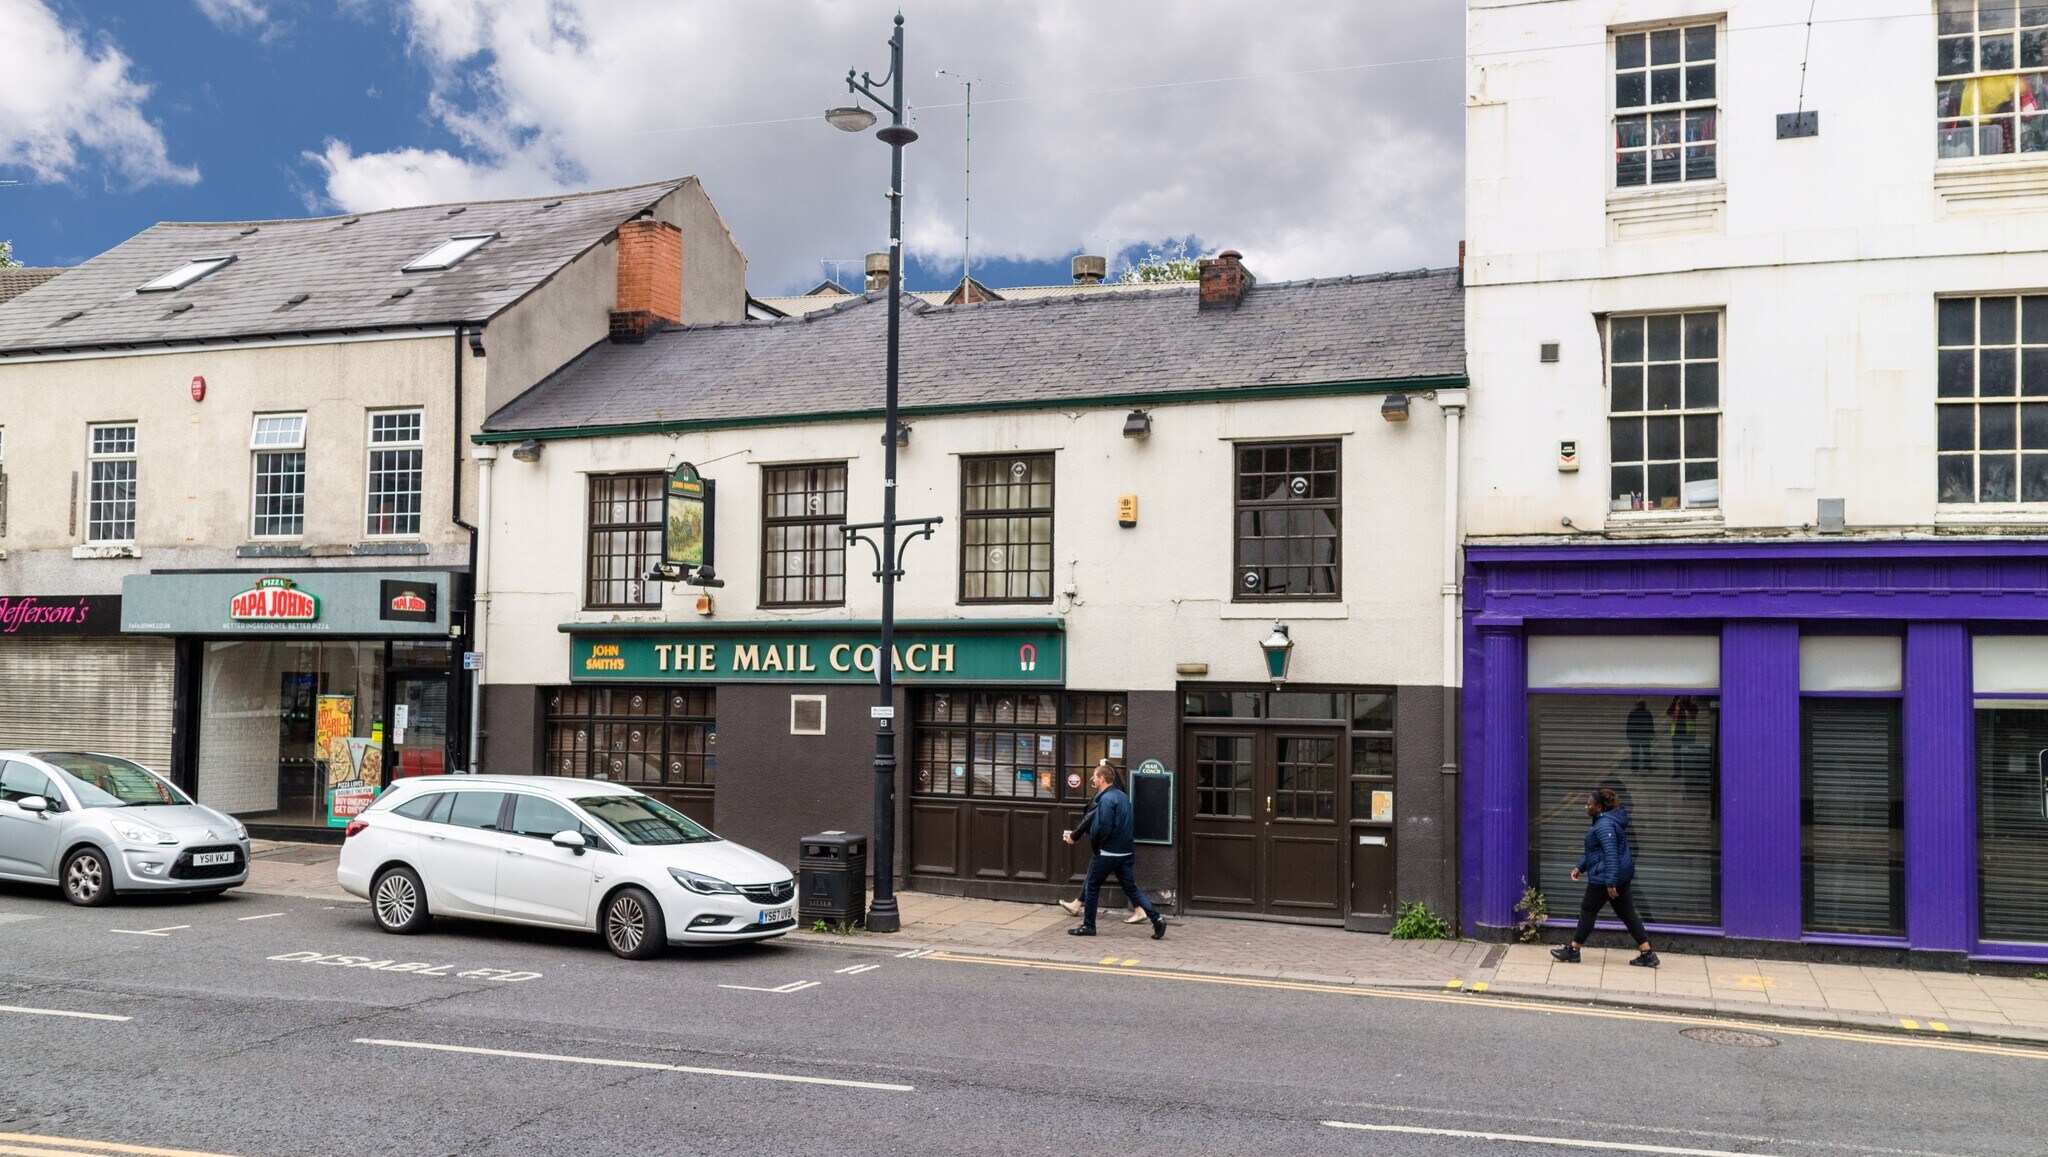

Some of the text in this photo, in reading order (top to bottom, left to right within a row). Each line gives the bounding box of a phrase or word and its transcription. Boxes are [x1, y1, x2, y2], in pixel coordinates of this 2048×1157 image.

[262, 578, 284, 586] PIZZA
[232, 590, 313, 617] PAPA JOHNS
[222, 622, 245, 630] BETTER
[287, 622, 311, 630] BETTER
[592, 644, 619, 657] JOHN
[654, 644, 717, 671] THE
[732, 644, 817, 672] MAIL
[585, 657, 625, 670] SMITH'S
[335, 797, 347, 805] BUY
[347, 798, 357, 806] ONE
[334, 805, 346, 814] GET
[215, 853, 229, 862] VKJ
[763, 911, 781, 921] YS67
